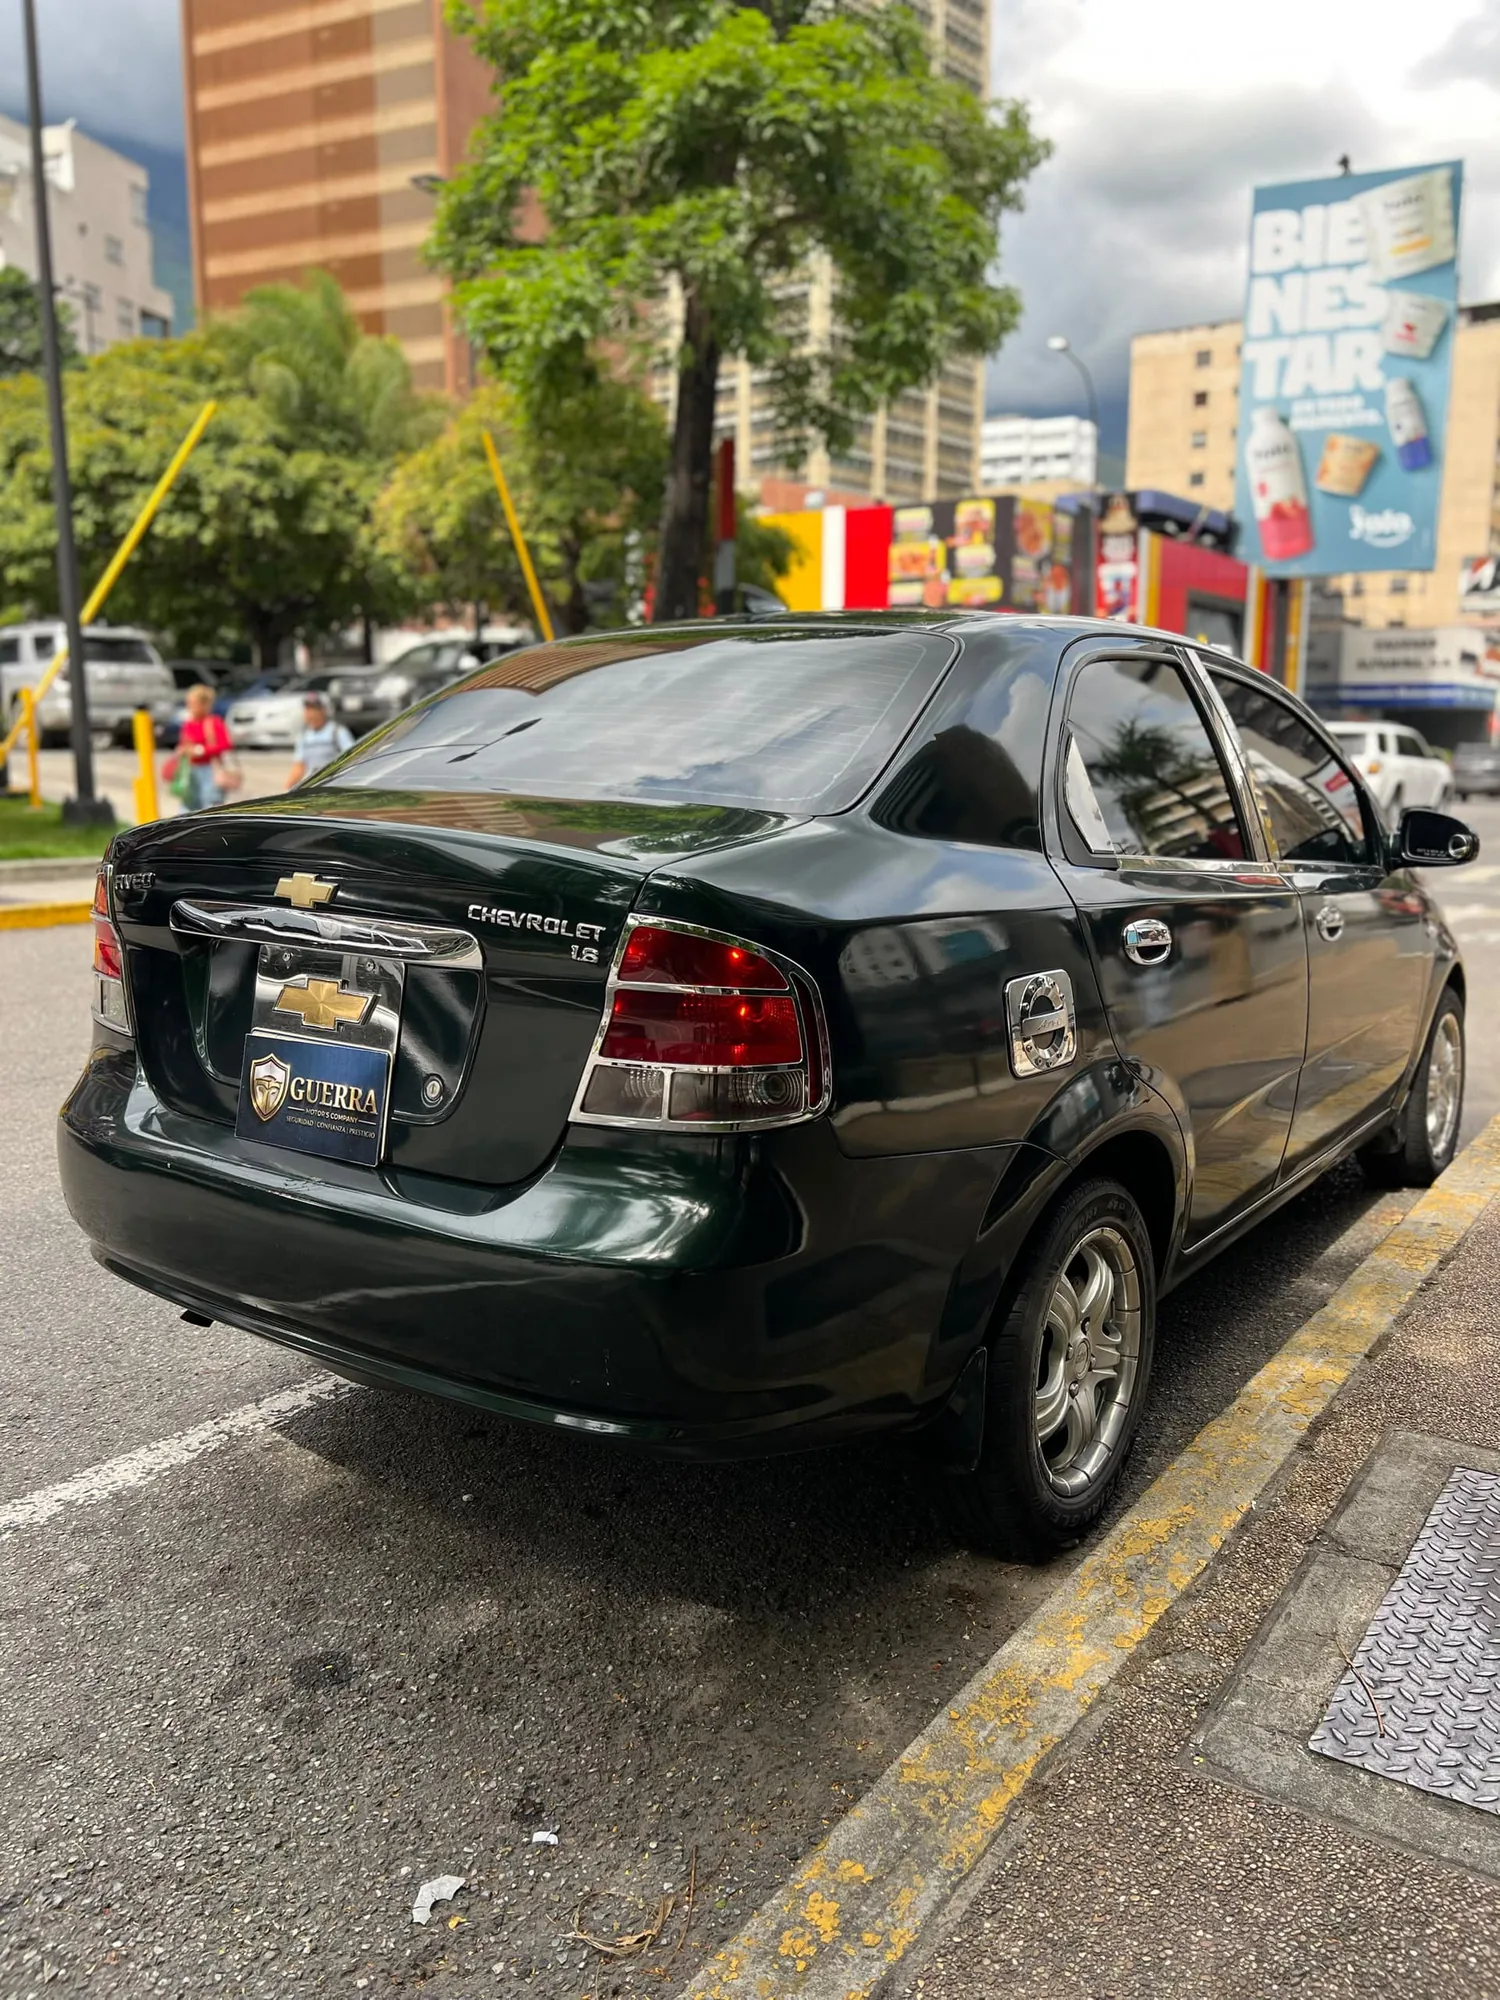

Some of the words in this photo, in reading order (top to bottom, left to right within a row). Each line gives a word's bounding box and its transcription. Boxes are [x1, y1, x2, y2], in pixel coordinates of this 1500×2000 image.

[1253, 201, 1368, 274] BIE
[1249, 264, 1388, 337] NES
[1244, 332, 1386, 399] TAR
[467, 904, 606, 941] CHEVROLET
[570, 944, 599, 964] 1.6
[289, 1076, 379, 1115] GUERRA
[286, 1115, 314, 1127] SEGURIDAD
[316, 1121, 346, 1133] CONFIANZA
[348, 1127, 375, 1139] PRESTIGIO
[330, 1112, 359, 1124] COMPANY
